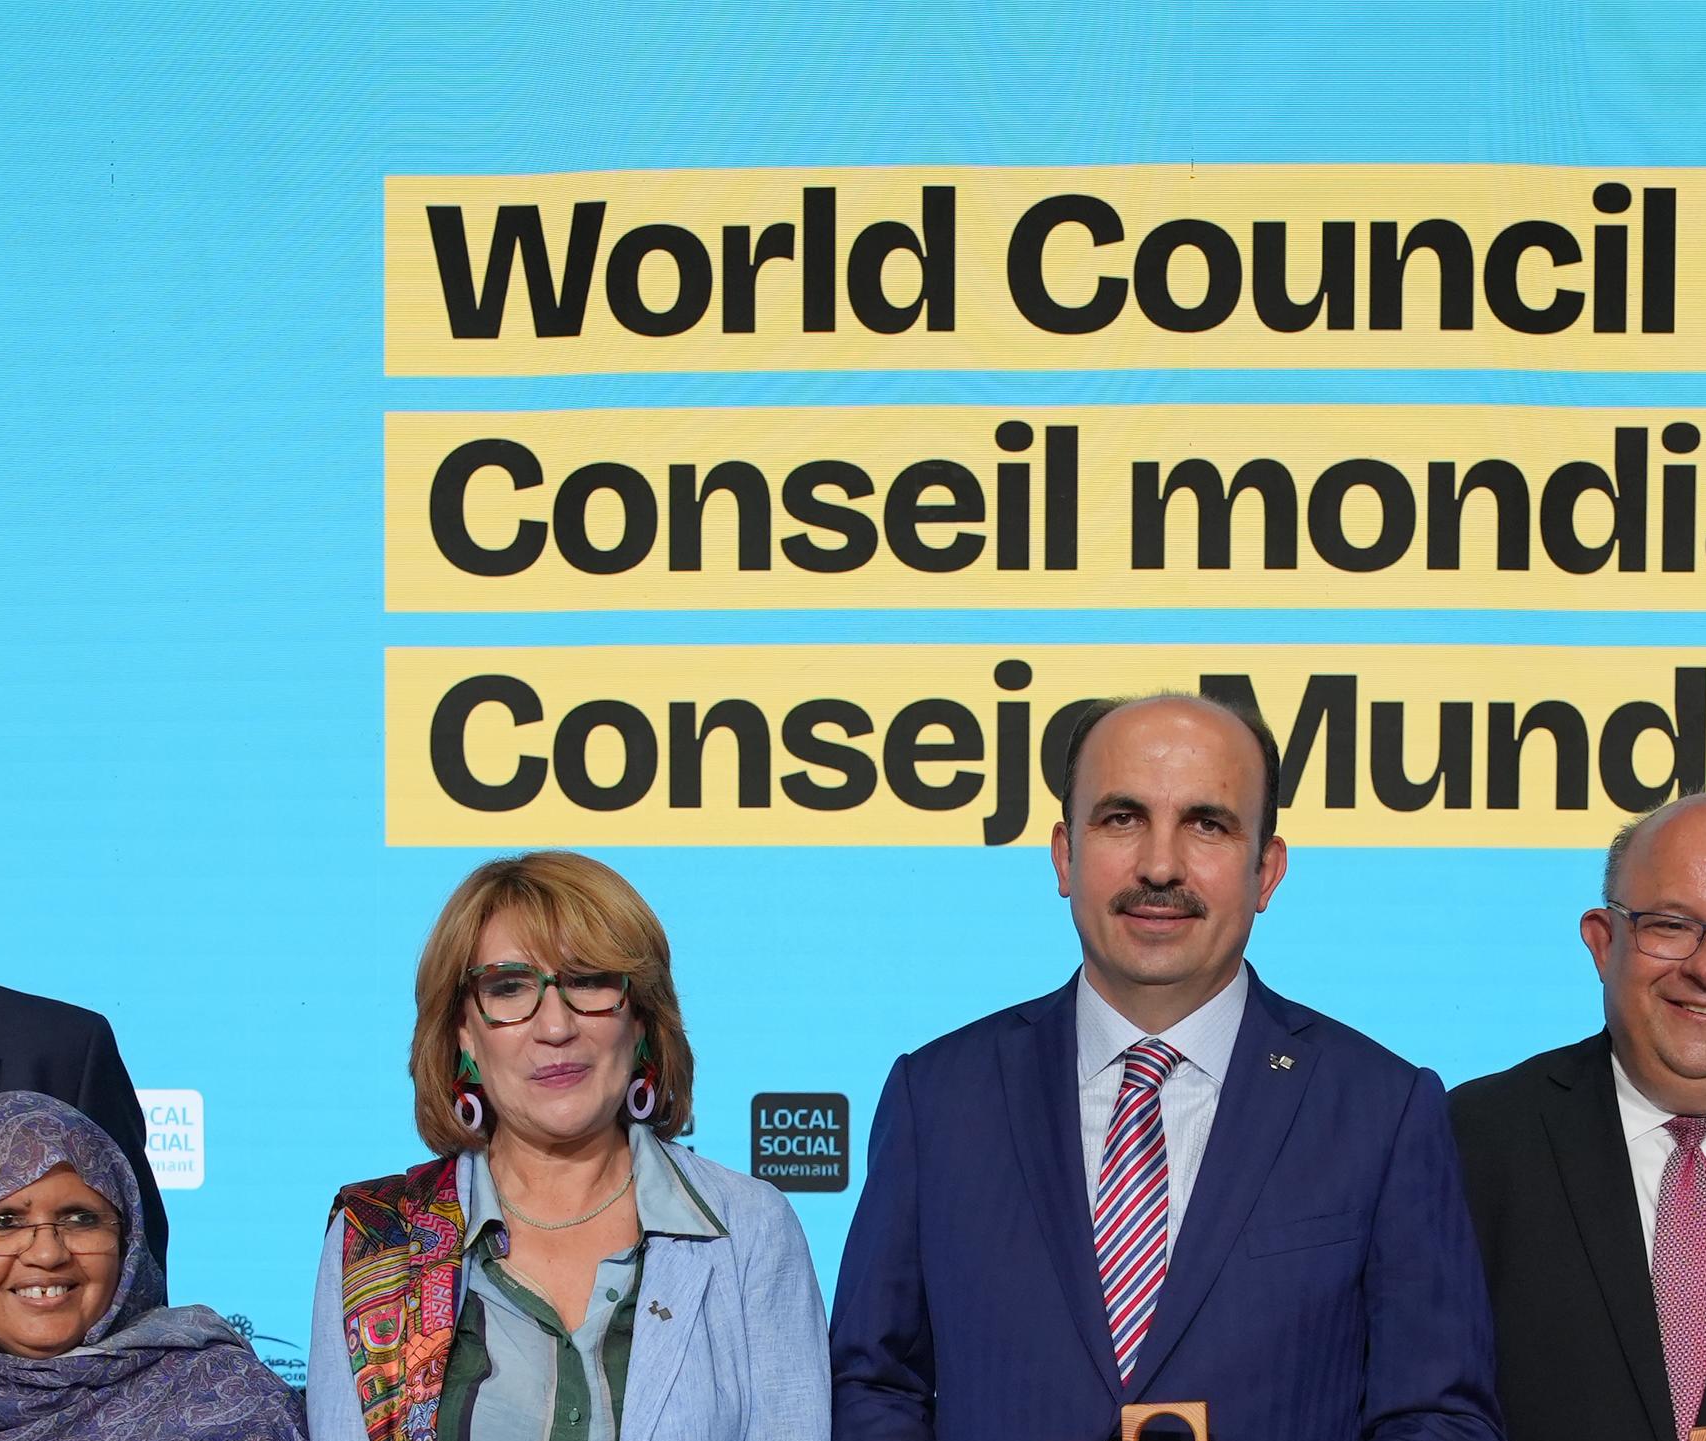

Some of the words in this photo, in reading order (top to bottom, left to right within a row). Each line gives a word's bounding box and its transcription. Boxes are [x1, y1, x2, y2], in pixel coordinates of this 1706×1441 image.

[425, 185, 957, 340] World
[1006, 182, 1677, 335] Council
[429, 420, 1079, 578] Conseil
[145, 1106, 195, 1126] CAL
[759, 1108, 841, 1130] LOCAL
[148, 1132, 196, 1152] CIAL
[759, 1135, 842, 1156] SOCIAL
[758, 1162, 841, 1177] covenant
